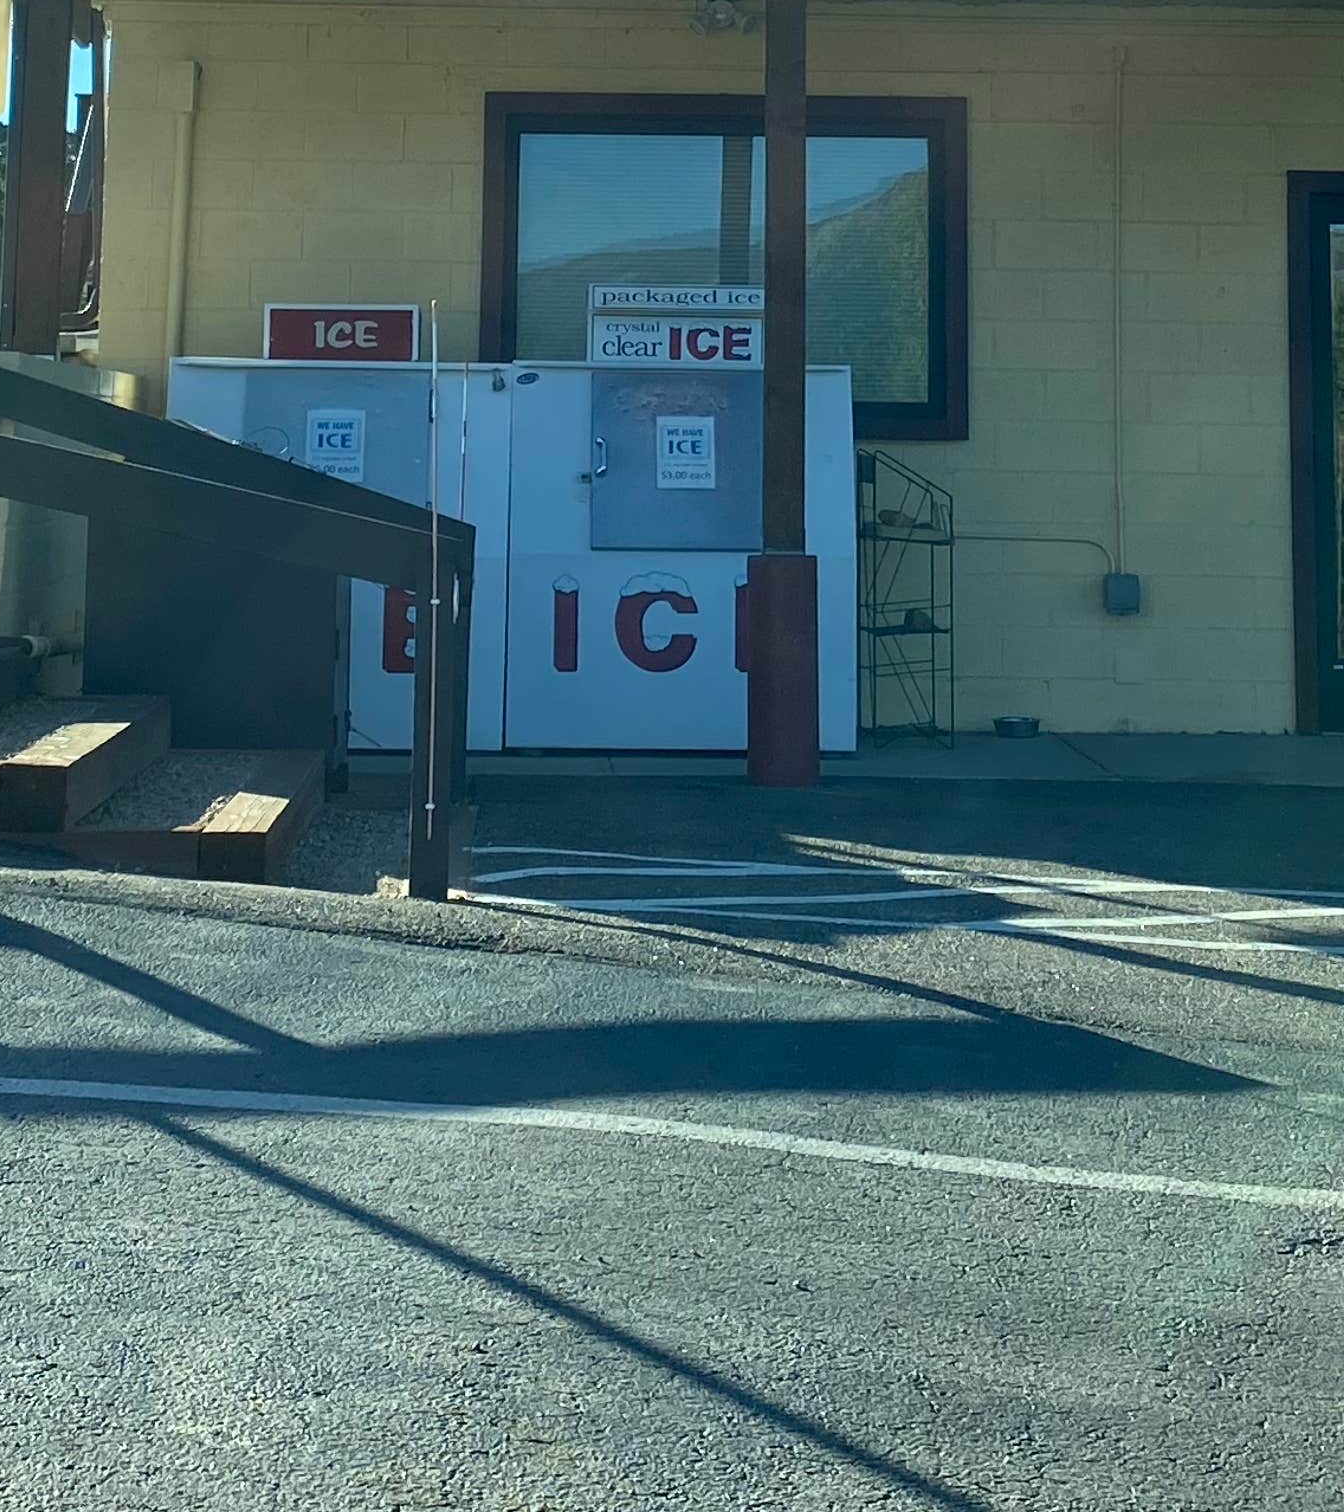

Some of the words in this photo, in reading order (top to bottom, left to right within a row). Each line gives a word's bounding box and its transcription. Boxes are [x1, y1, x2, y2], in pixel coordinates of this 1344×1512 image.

[601, 289, 718, 306] packaged
[728, 291, 761, 304] ice
[313, 320, 379, 349] ICE
[606, 321, 660, 334] crystal
[602, 335, 663, 357] clear
[669, 325, 752, 361] ICE
[318, 433, 353, 448] ICE
[666, 428, 680, 437] WE
[682, 428, 704, 437] HAVE
[668, 439, 703, 455] ICE
[338, 466, 360, 474] each
[690, 471, 712, 481] each
[553, 571, 748, 674] IC
